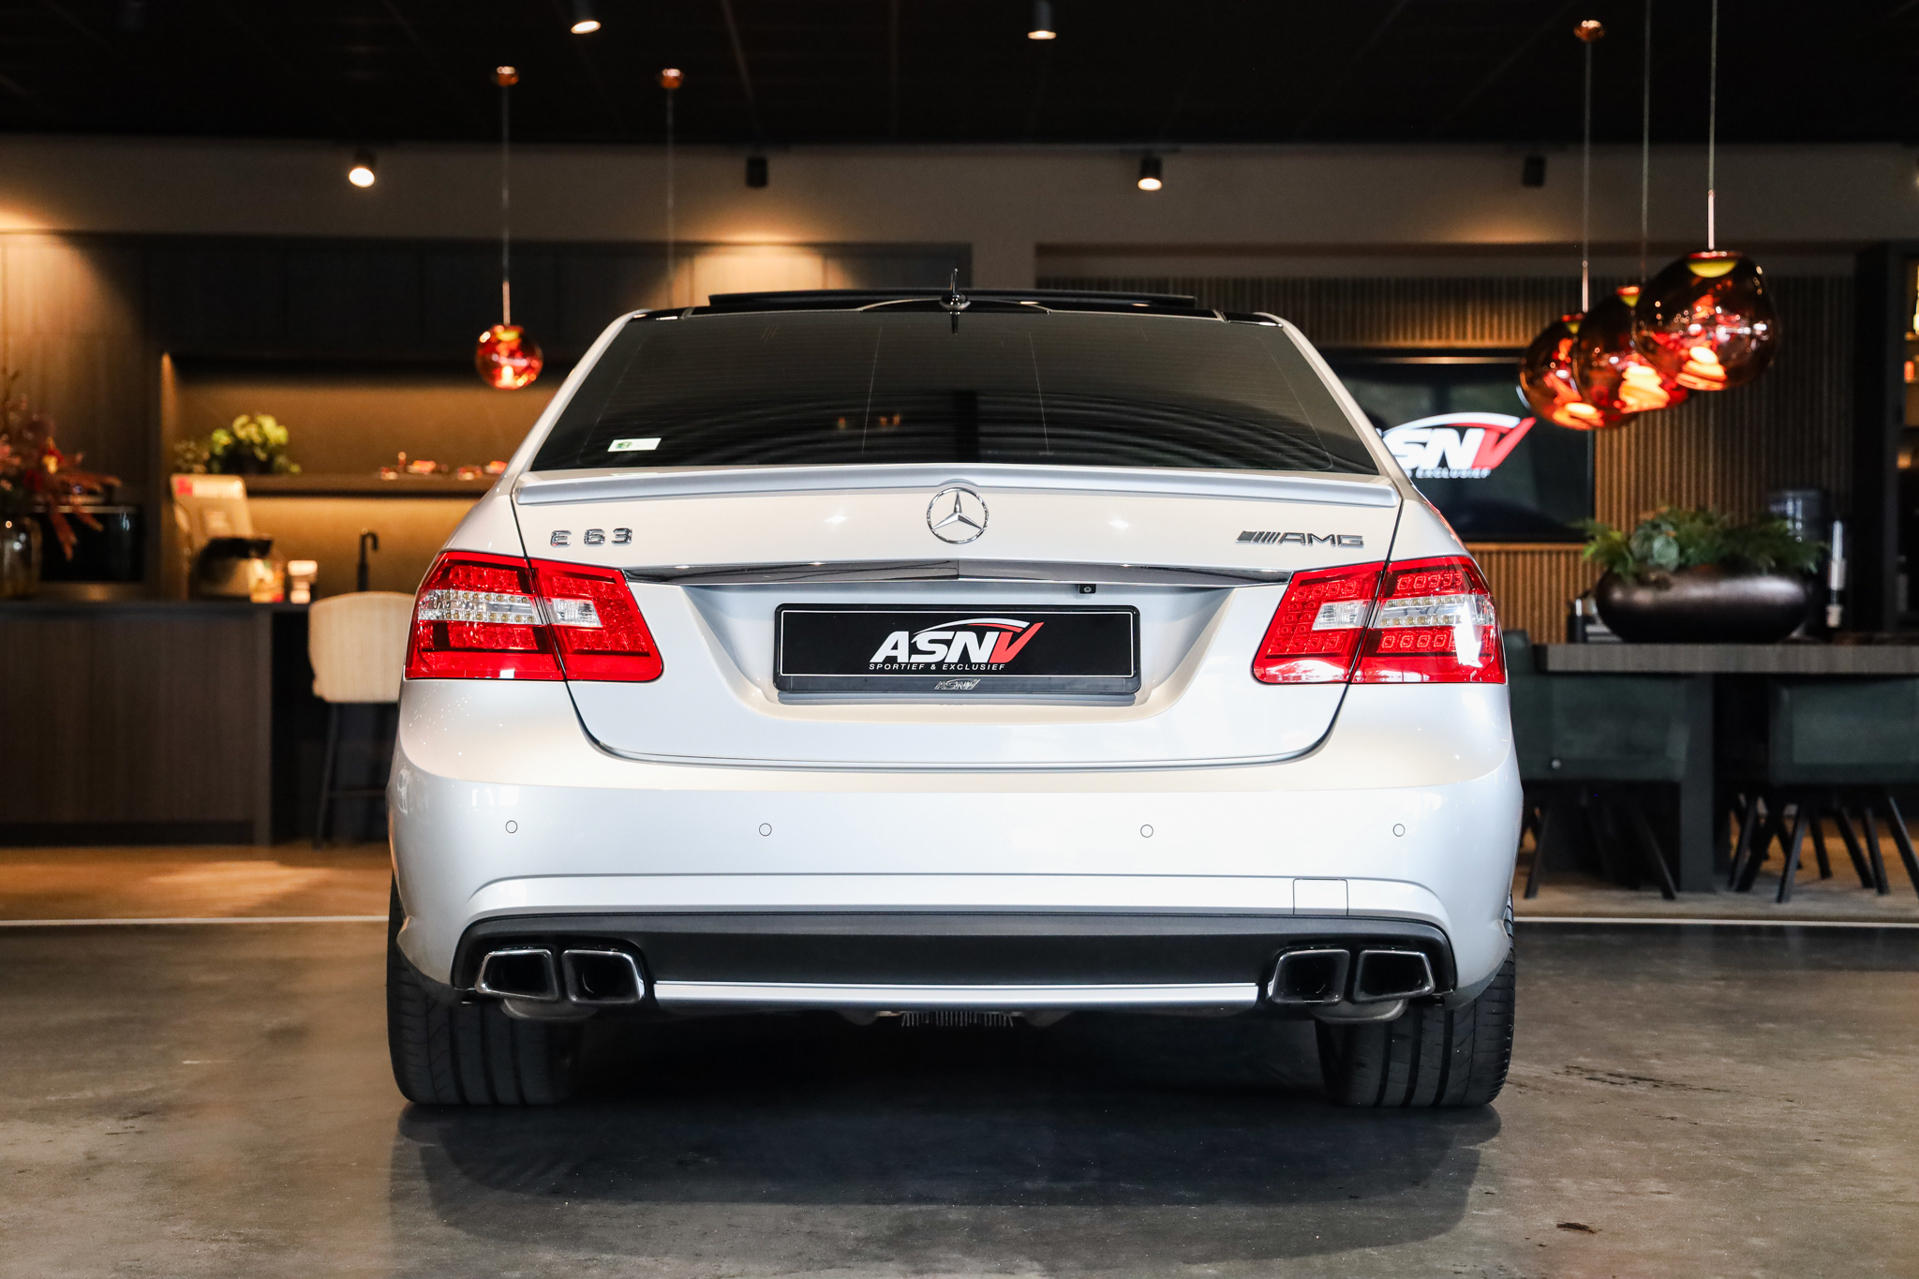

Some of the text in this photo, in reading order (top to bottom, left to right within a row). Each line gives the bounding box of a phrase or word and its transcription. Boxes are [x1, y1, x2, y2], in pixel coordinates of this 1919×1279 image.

[1375, 415, 1537, 470] SNV
[550, 527, 633, 547] E 63
[1277, 532, 1364, 548] AMG
[869, 619, 1044, 663] ASNV
[868, 663, 1006, 671] SPORTIEF & EXCLUSIEF
